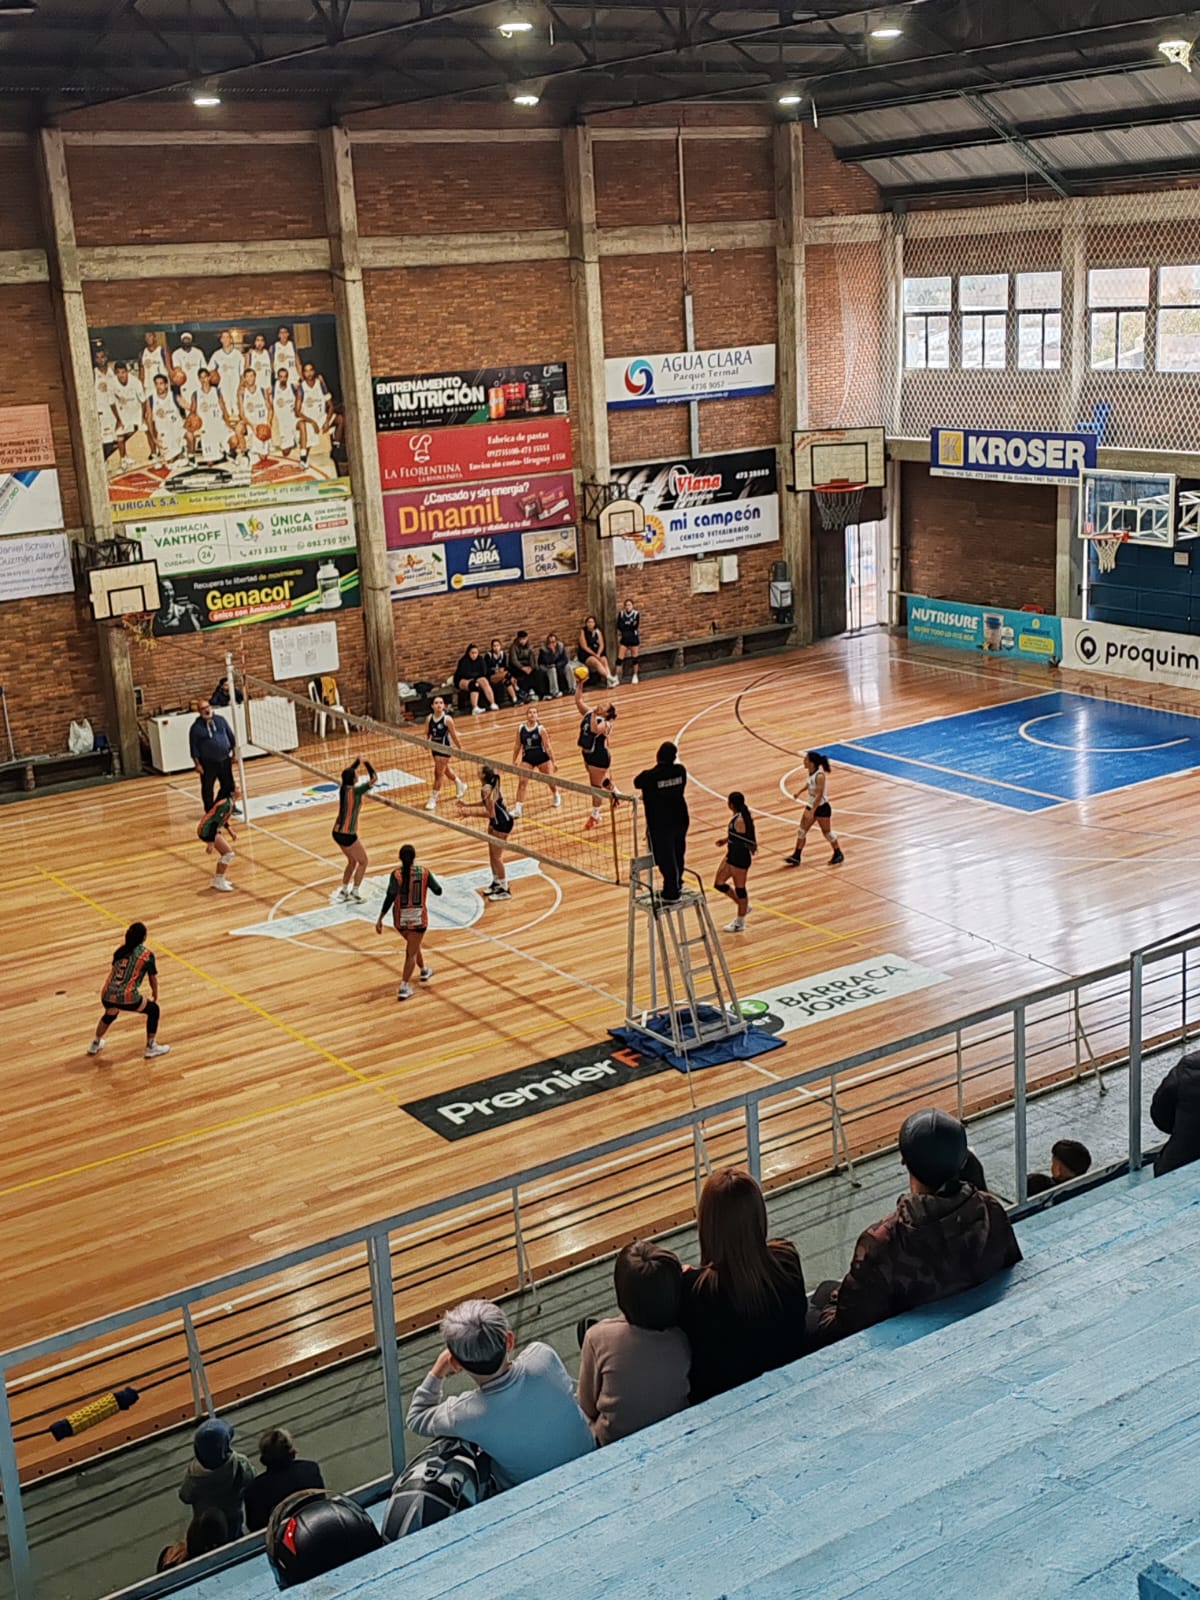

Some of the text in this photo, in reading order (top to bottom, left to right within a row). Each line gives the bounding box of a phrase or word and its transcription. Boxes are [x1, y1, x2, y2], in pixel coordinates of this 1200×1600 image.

[661, 350, 752, 373] AGUA CLARA
[673, 367, 739, 381] Parque Termal
[376, 376, 462, 395] ENTRENAMIENTO
[393, 382, 485, 411] NUTRICIÓN
[968, 436, 1086, 470] KROSER
[384, 463, 461, 480] LA FLORENTINA
[677, 475, 721, 492] Viana
[424, 481, 530, 506] ¿Cansado y sin energía?
[112, 496, 179, 513] TURIGAL S.A.
[270, 511, 312, 527] ÚNICA
[399, 496, 503, 535] Dinamil
[670, 505, 761, 531] mi campeón
[163, 523, 209, 534] FARMACIA
[271, 524, 314, 536] 24 HORAS
[680, 525, 749, 541] CENTRO VETERINARIO
[154, 530, 221, 548] VANTHOFF
[202, 550, 211, 558] 24
[534, 543, 556, 553] FINES
[468, 550, 500, 565] ABRA
[535, 555, 545, 563] DE
[535, 562, 558, 573] OBRA
[911, 606, 979, 630] NUTRISURE
[776, 964, 908, 1013] BARRACA
[799, 983, 886, 1017] JORGE
[437, 1059, 617, 1125] Premier
